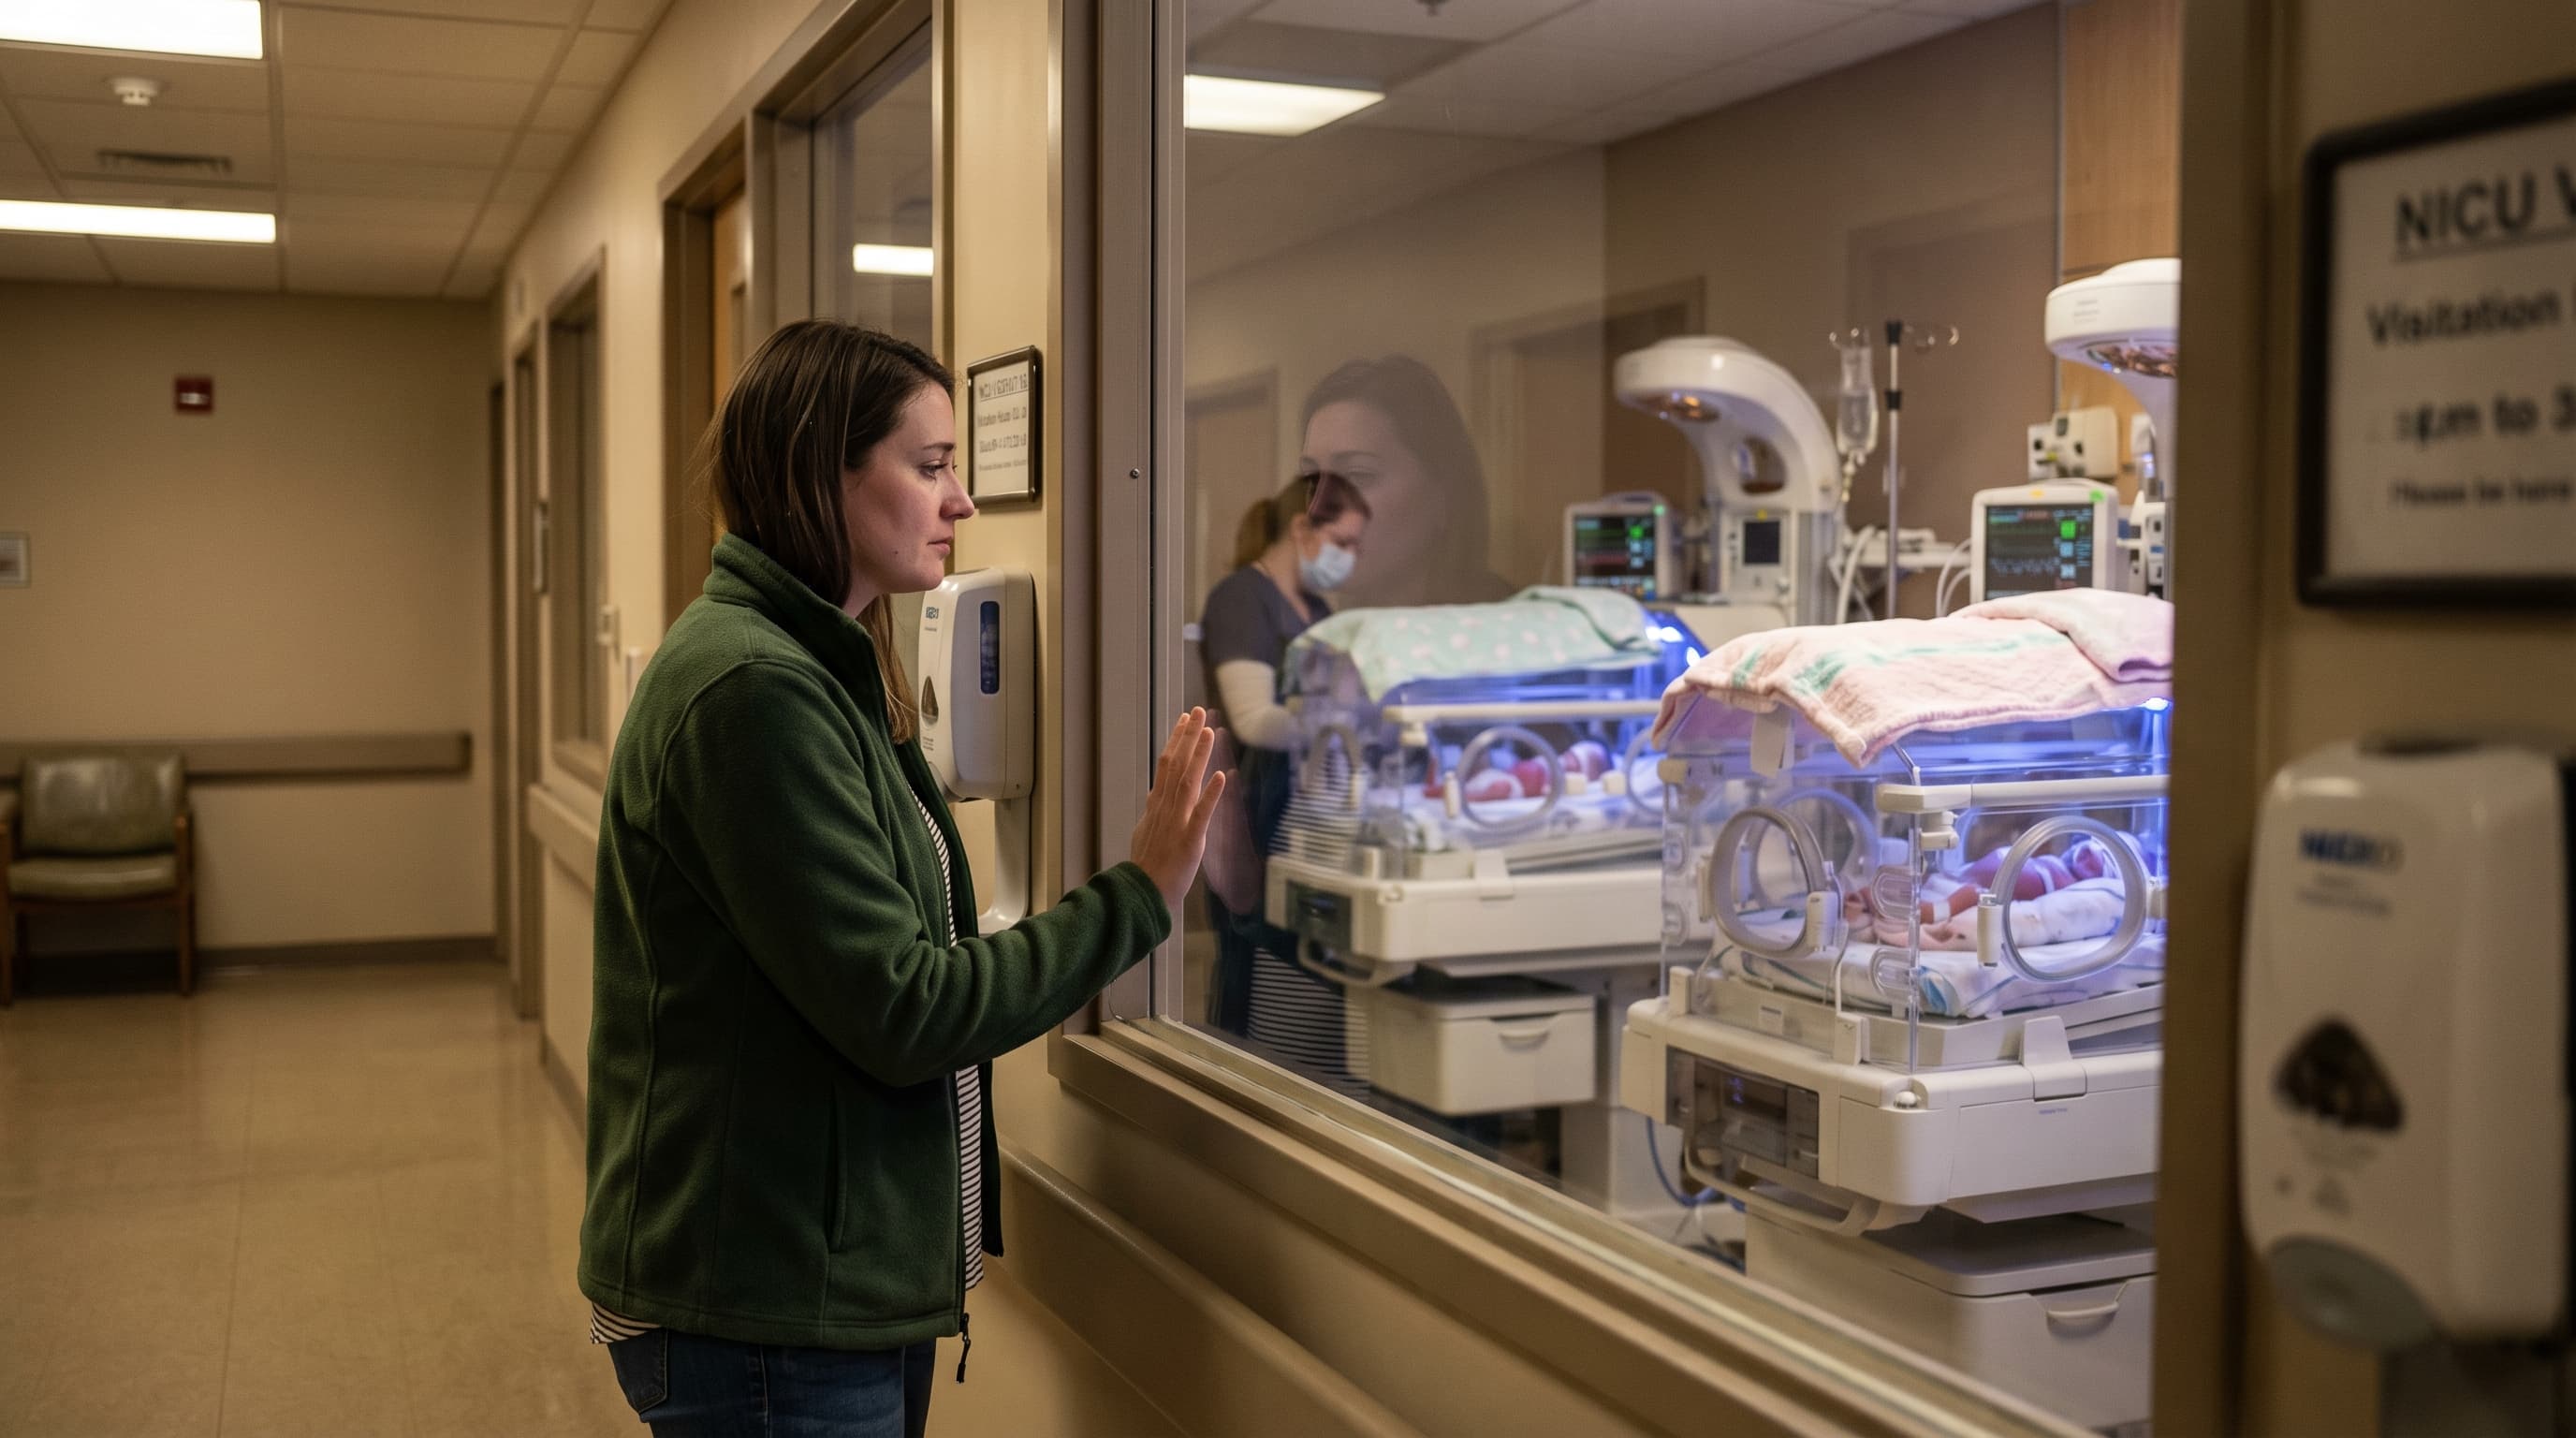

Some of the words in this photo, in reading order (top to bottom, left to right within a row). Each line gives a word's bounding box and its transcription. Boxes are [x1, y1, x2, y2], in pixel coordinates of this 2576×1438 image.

[2395, 175, 2536, 244] NICU
[2365, 288, 2561, 346] Visitation
[2493, 391, 2539, 437] to
